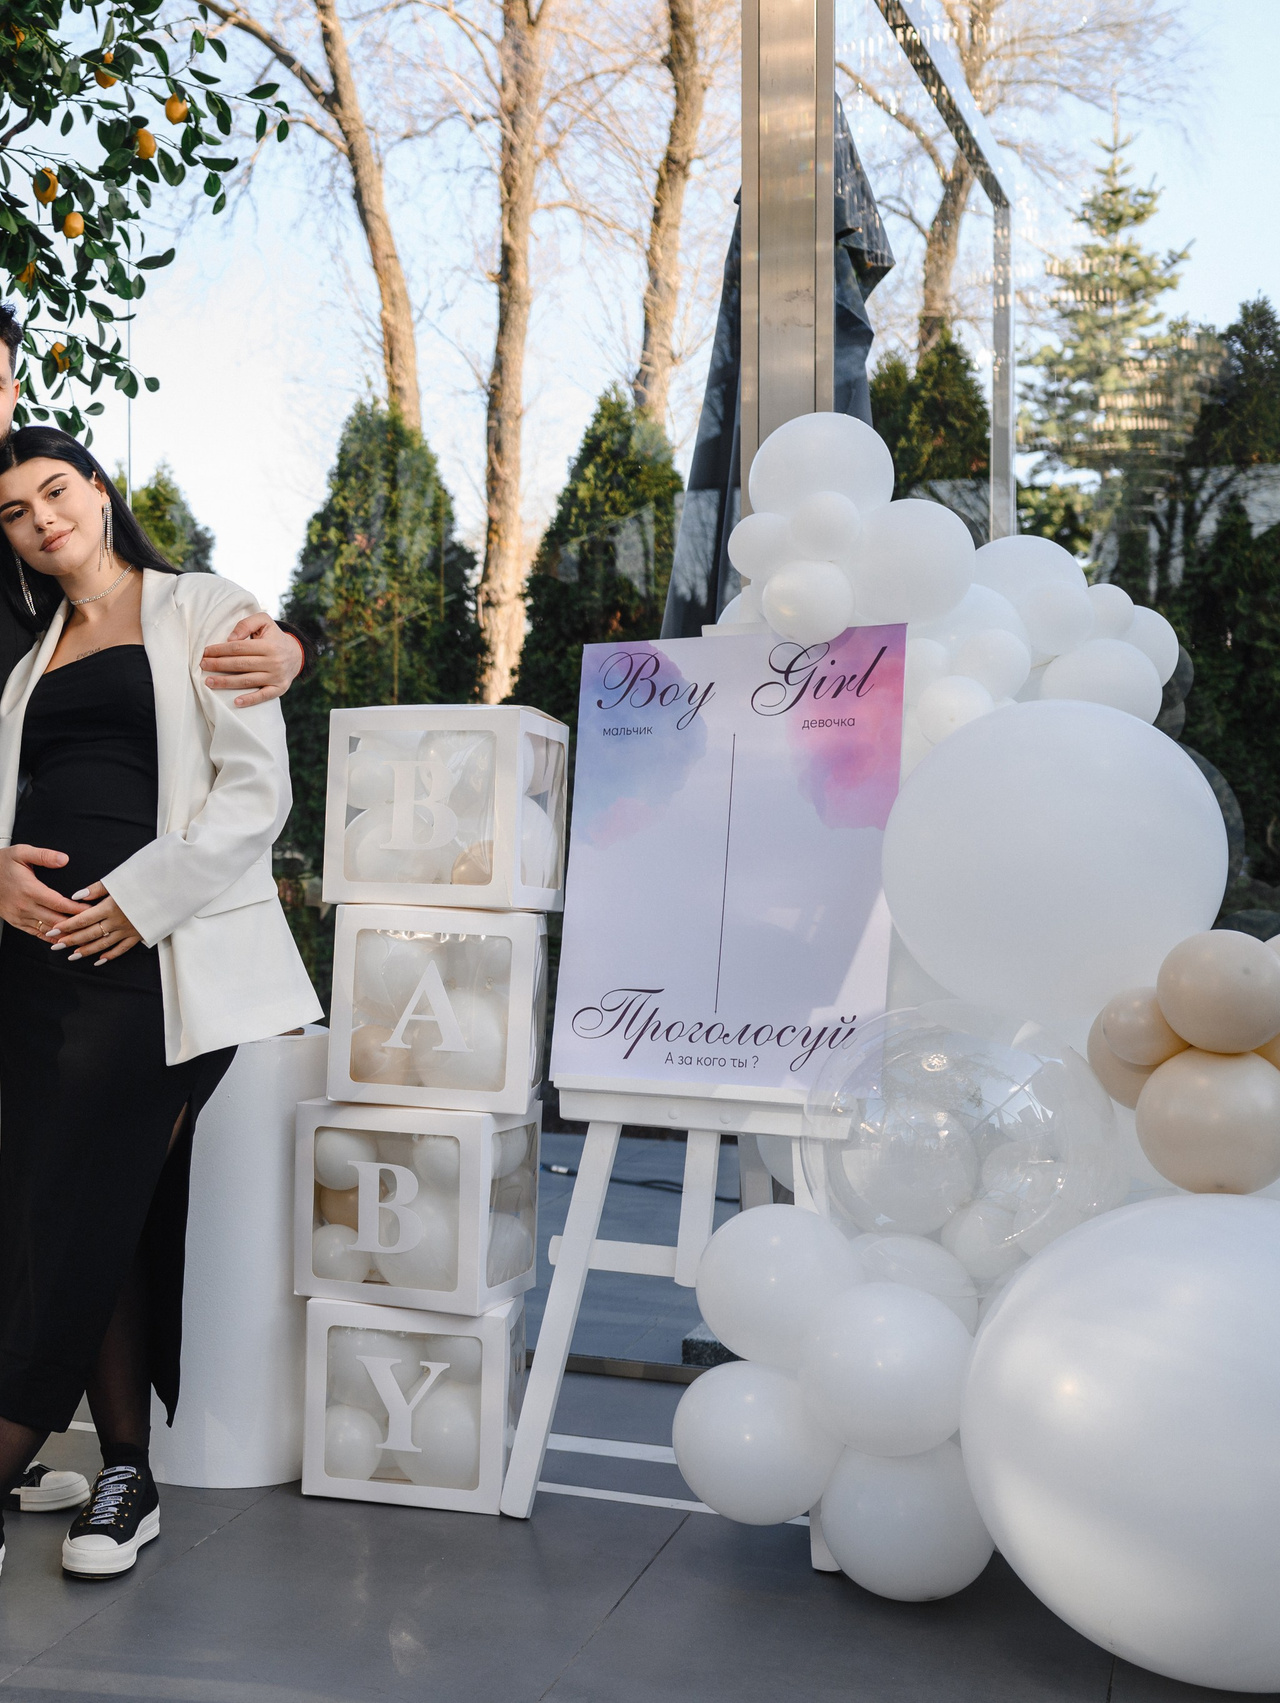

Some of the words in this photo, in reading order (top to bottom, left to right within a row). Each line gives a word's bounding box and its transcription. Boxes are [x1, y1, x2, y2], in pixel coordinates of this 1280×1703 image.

[596, 651, 716, 731] Boy
[751, 641, 888, 717] Girl
[602, 725, 653, 737] мальчик
[801, 716, 856, 731] девочка
[571, 987, 858, 1072] Проголосуй
[664, 1051, 675, 1066] А
[677, 1055, 693, 1066] за
[696, 1056, 727, 1068] кого
[729, 1057, 748, 1069] ты
